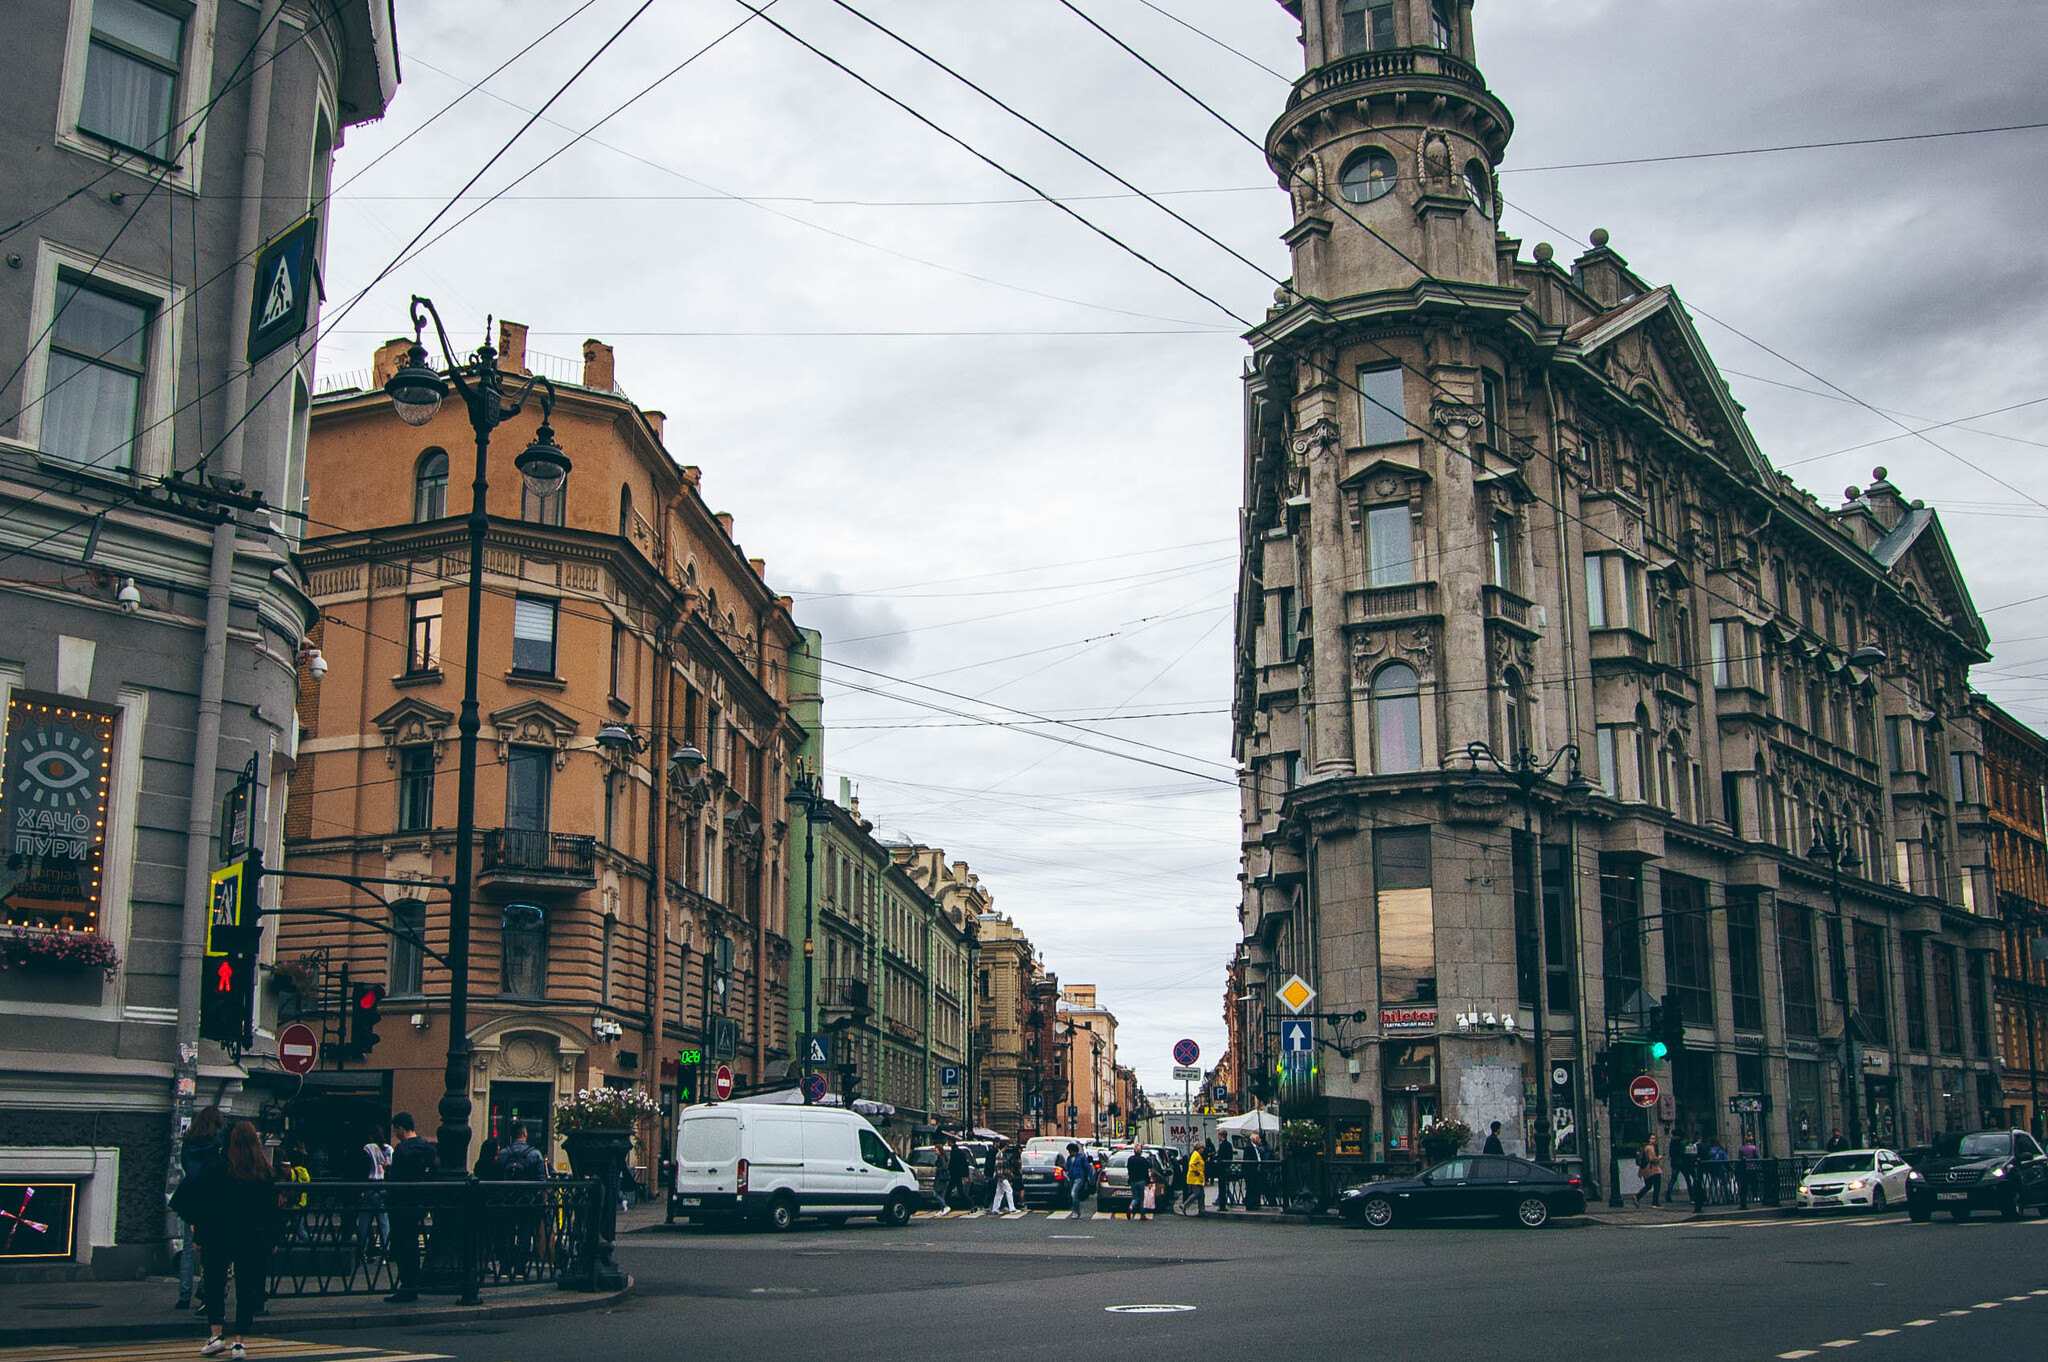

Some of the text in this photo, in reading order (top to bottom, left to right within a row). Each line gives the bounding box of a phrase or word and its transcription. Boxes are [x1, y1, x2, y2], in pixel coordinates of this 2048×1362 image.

[16, 807, 90, 834] ХАЧО
[15, 835, 88, 861] ПУРИ
[1380, 1008, 1436, 1023] bileter
[945, 1068, 956, 1084] P
[1217, 1087, 1225, 1099] P
